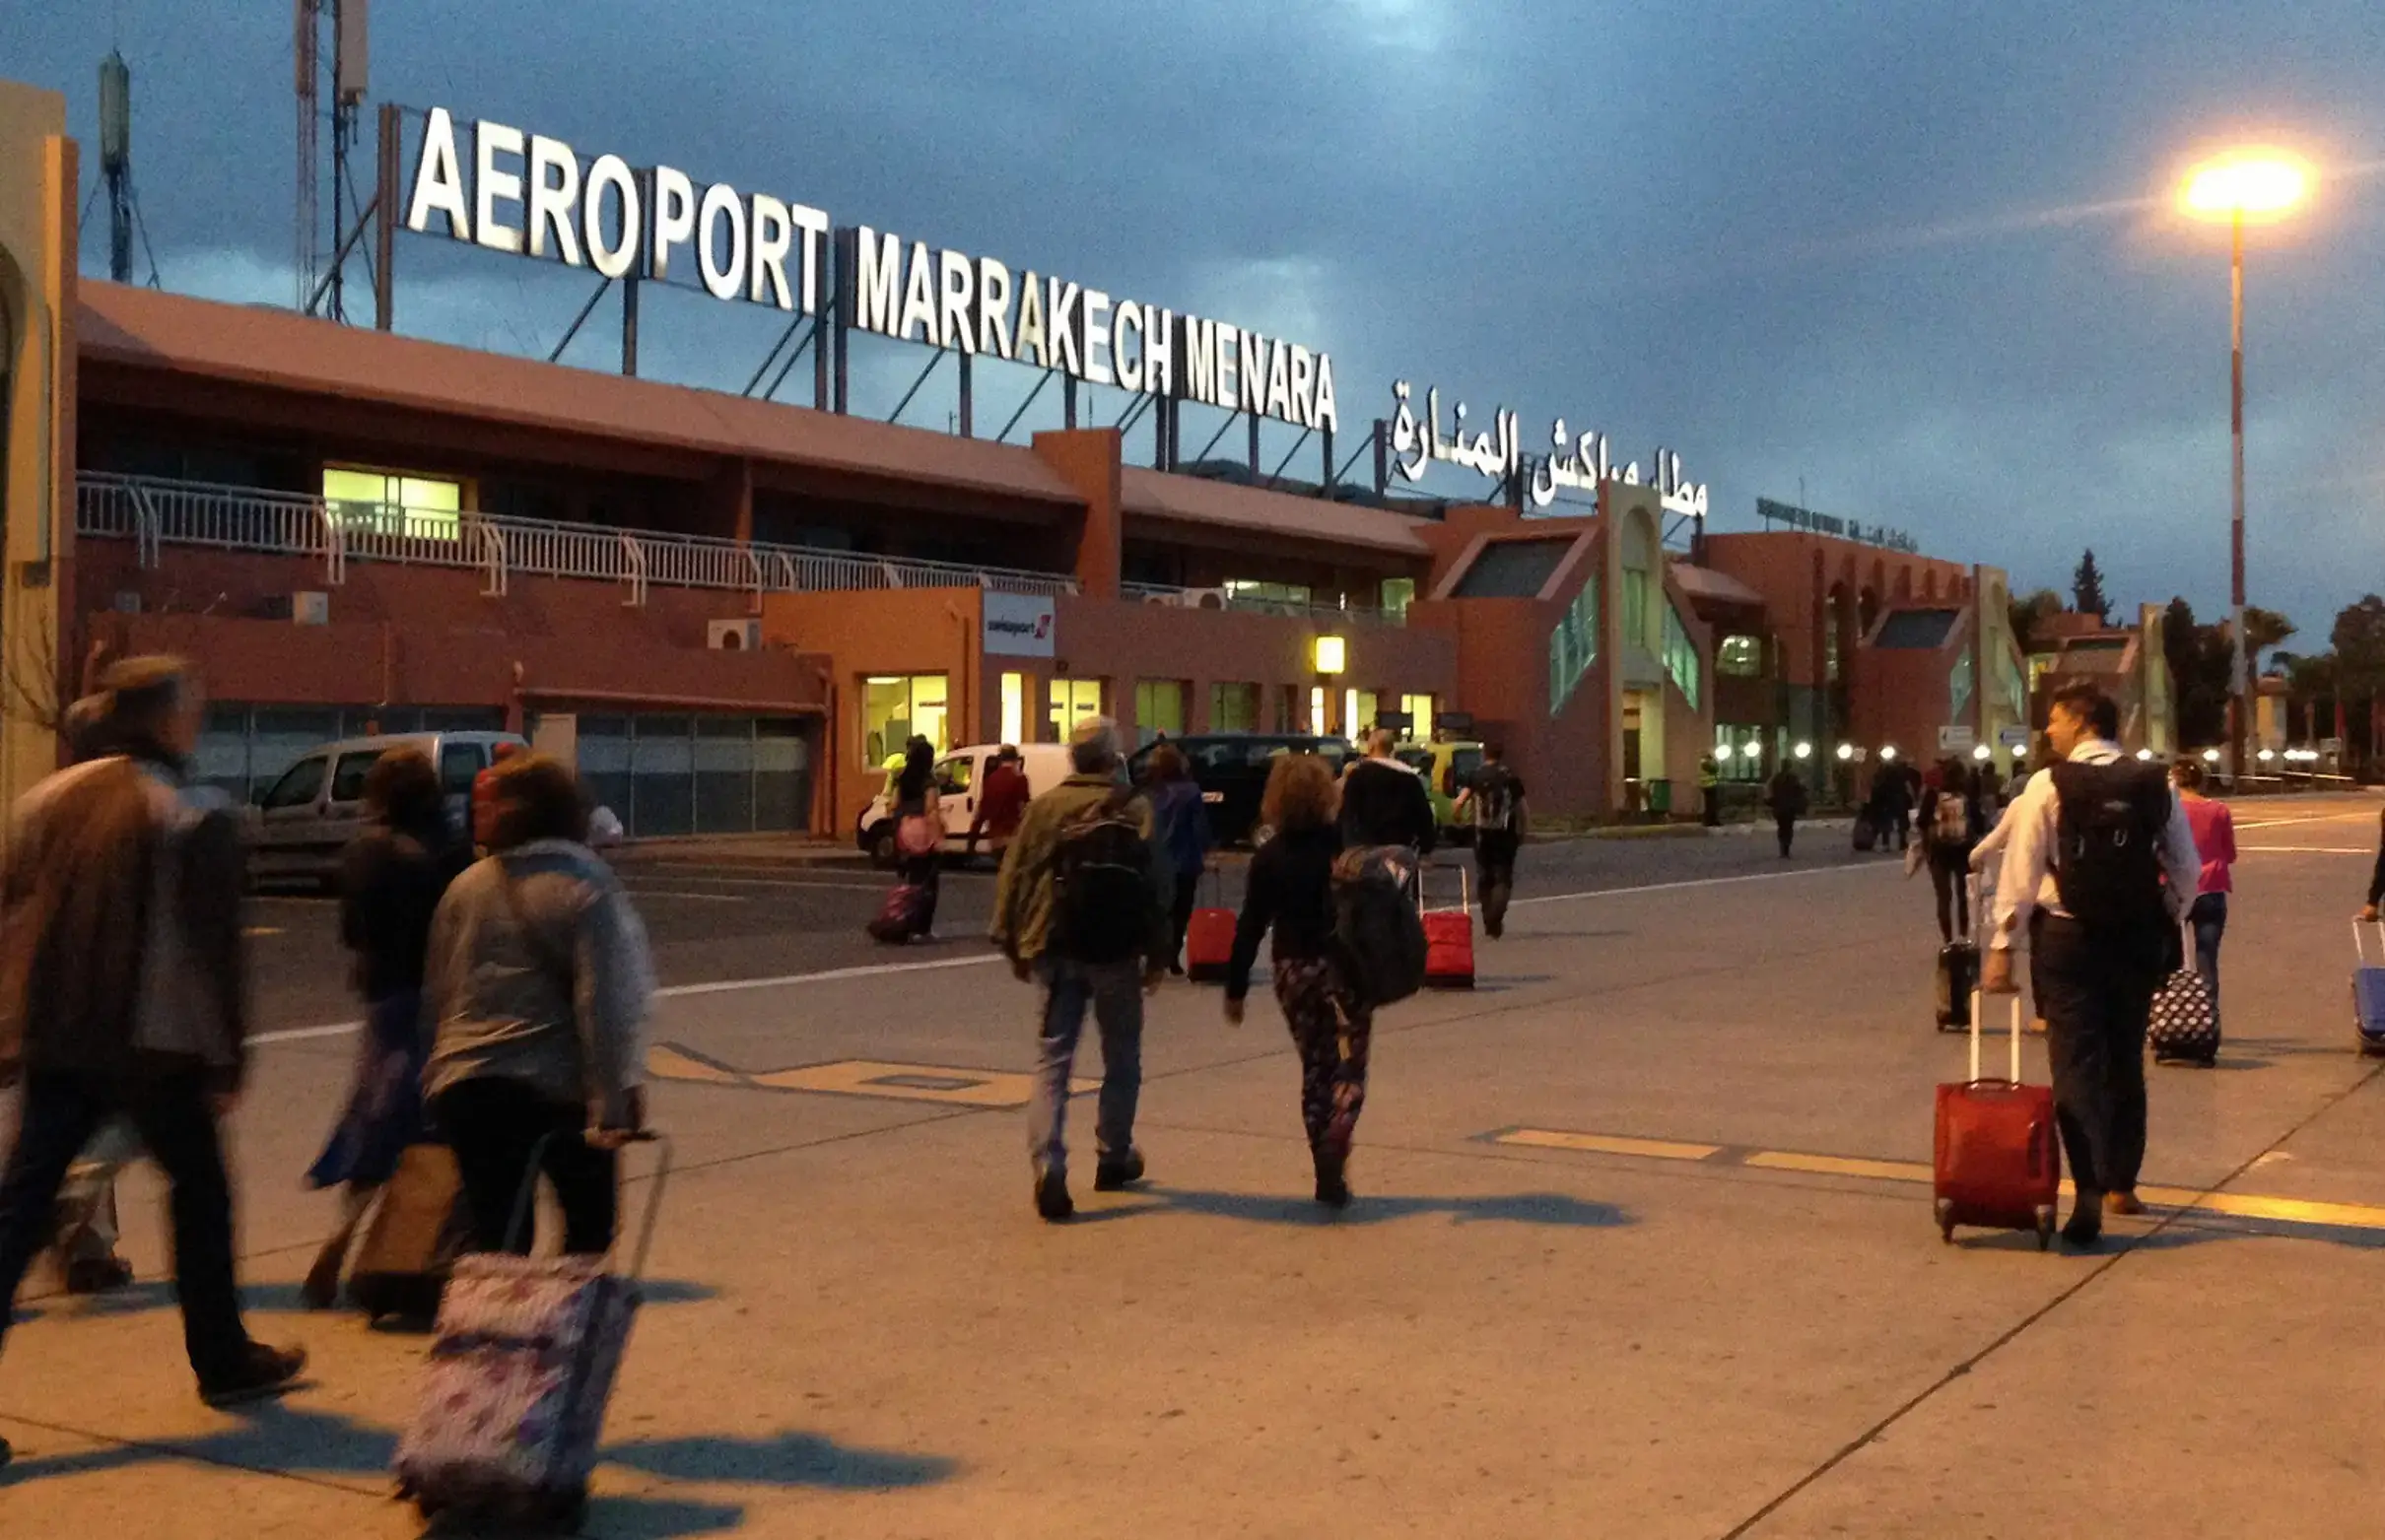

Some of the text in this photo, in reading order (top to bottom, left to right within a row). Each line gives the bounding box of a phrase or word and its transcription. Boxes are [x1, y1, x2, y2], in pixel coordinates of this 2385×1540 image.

[406, 105, 1338, 434] AEROPORT MARRAKECH MENARA
[1392, 379, 1519, 482] المنارة
[1652, 446, 1709, 517] مطا
